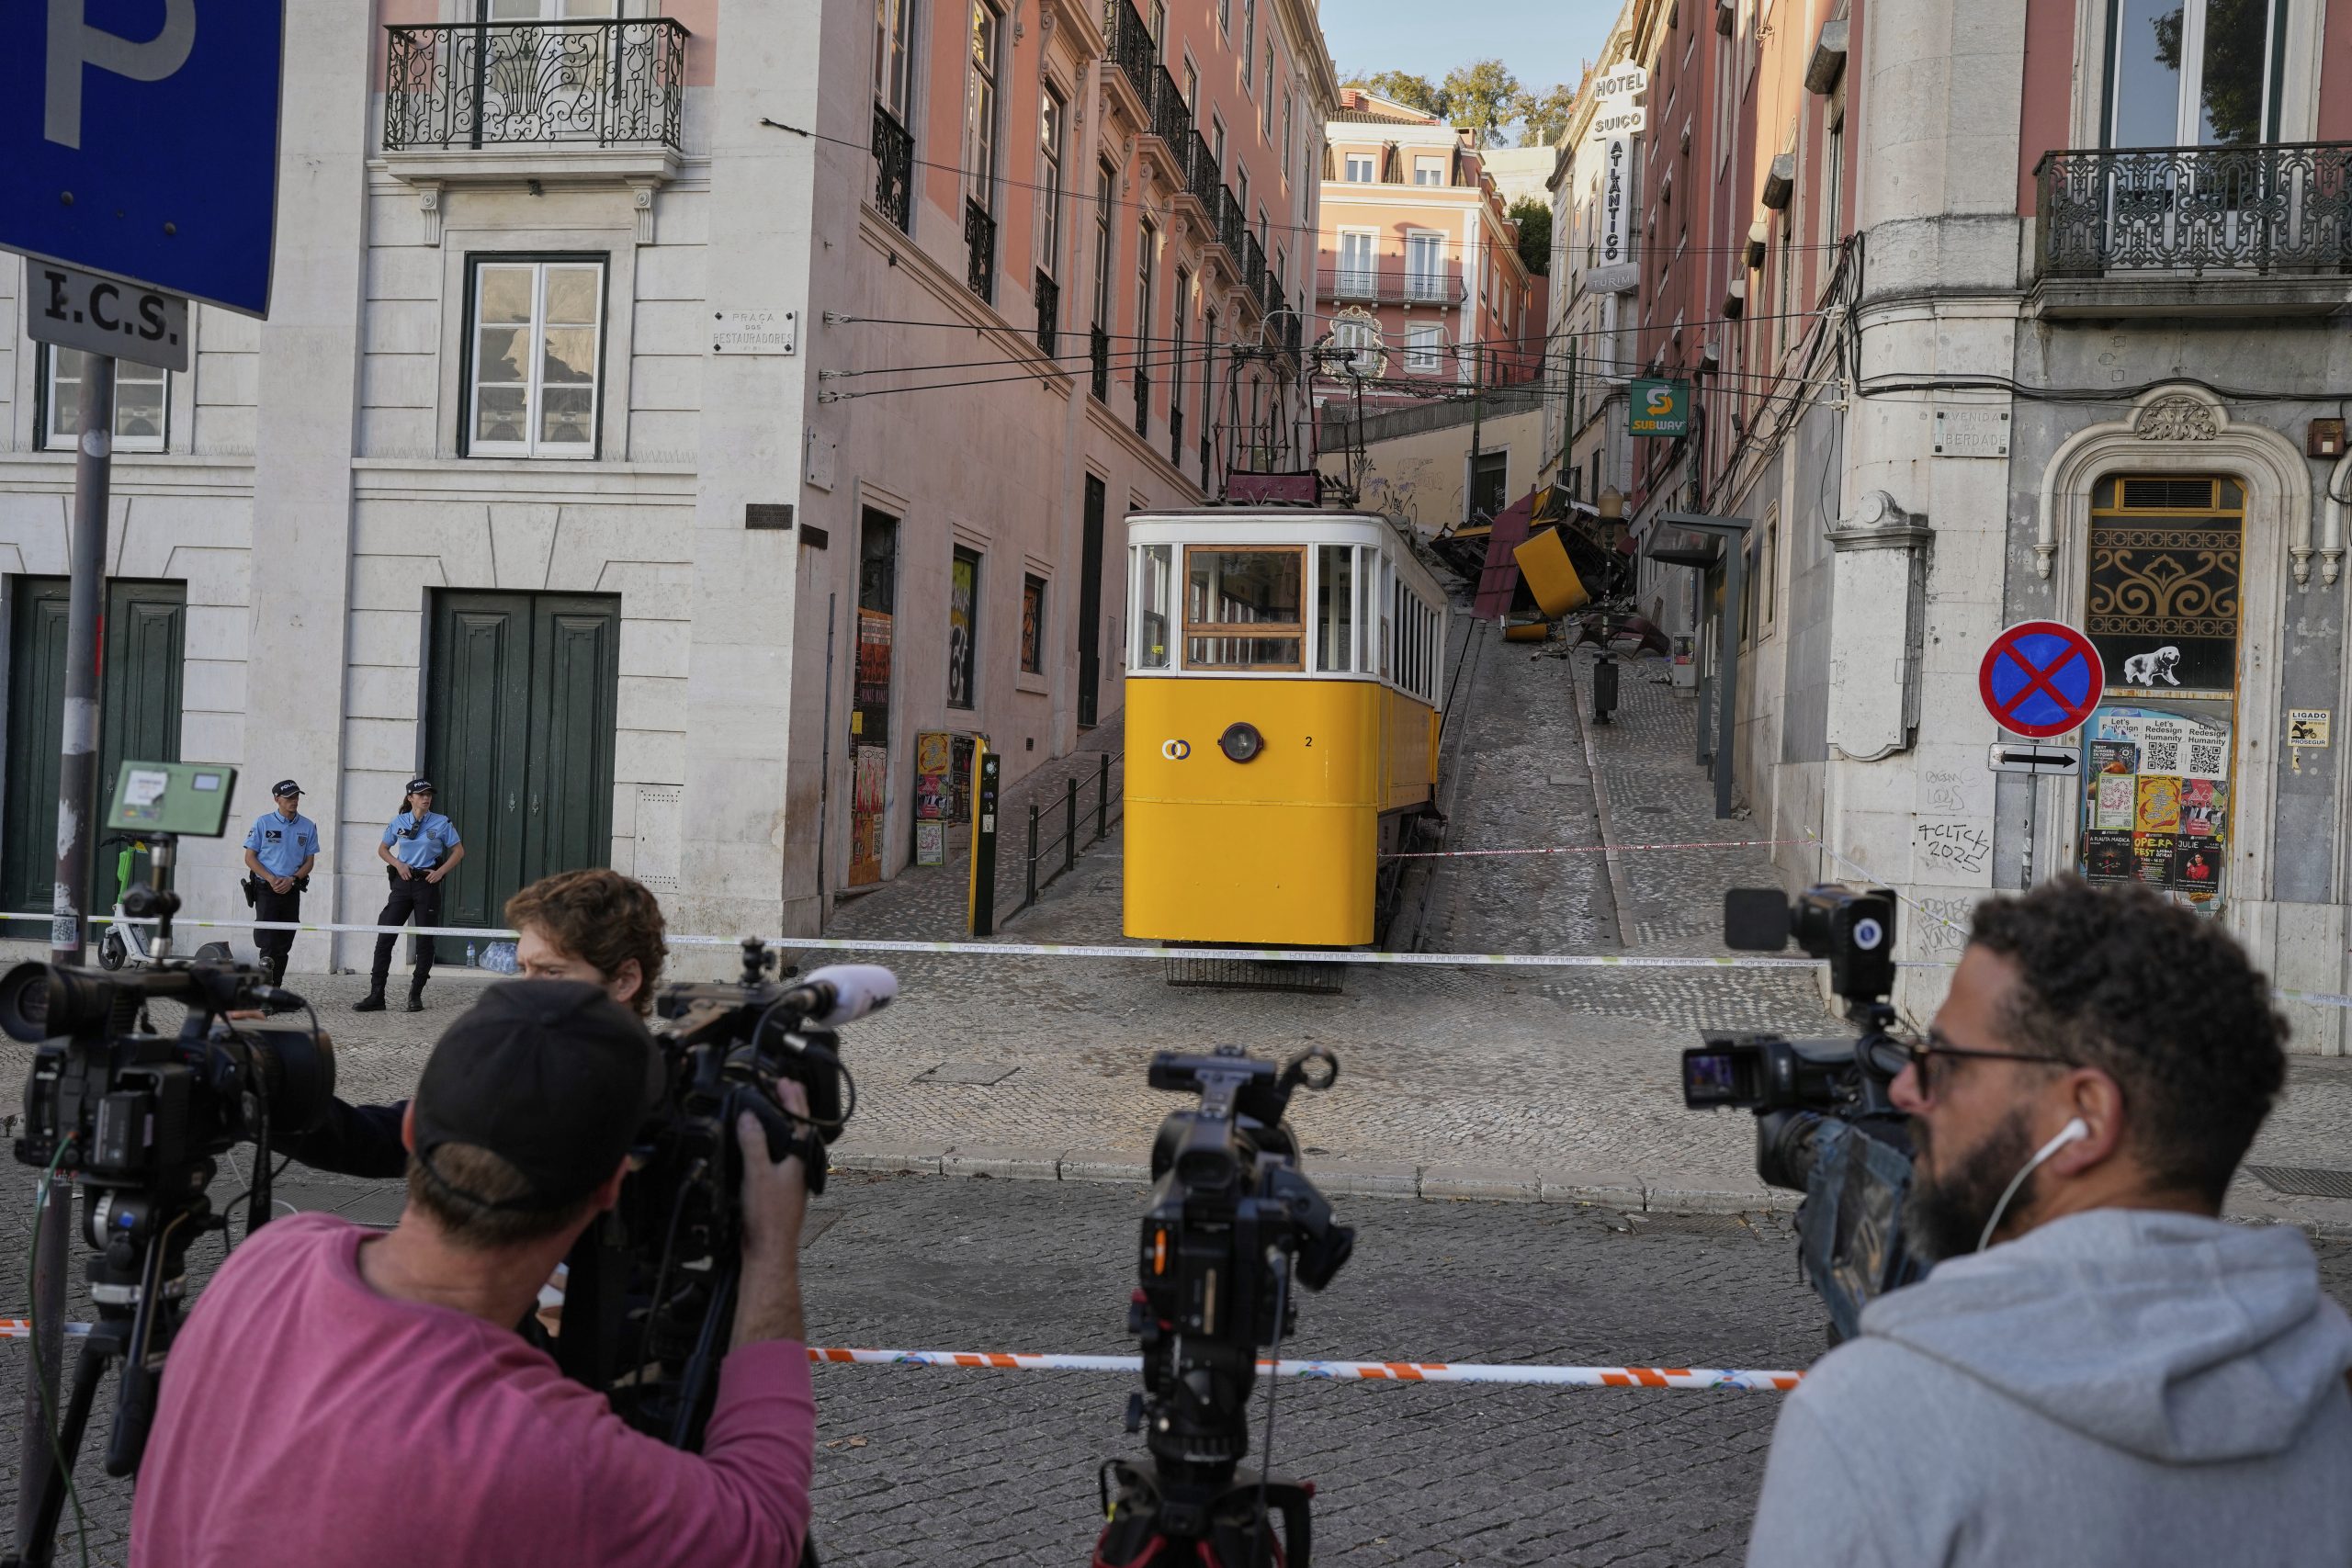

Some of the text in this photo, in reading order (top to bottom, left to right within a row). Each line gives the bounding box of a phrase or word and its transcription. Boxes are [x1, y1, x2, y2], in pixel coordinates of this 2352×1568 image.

[44, 0, 197, 151] P
[1595, 73, 1645, 97] HOTEL
[1594, 112, 1642, 133] SUIÇO
[1592, 276, 1630, 288] TURIM
[732, 313, 775, 324] PRAÇA
[713, 333, 793, 344] RESTAURADORES
[1943, 412, 2000, 423] AVENIDA
[1632, 419, 1684, 431] SUBWAY
[1933, 433, 2007, 446] LIBERDADE
[2145, 726, 2183, 737] Redesign
[2188, 728, 2226, 739] Redesign
[1305, 736, 1313, 747] 2
[2144, 734, 2182, 743] Humanity
[2188, 737, 2226, 747] Humanity
[2133, 837, 2174, 848] OPERA
[2177, 840, 2199, 849] JULIE
[2133, 848, 2155, 857] FEST
